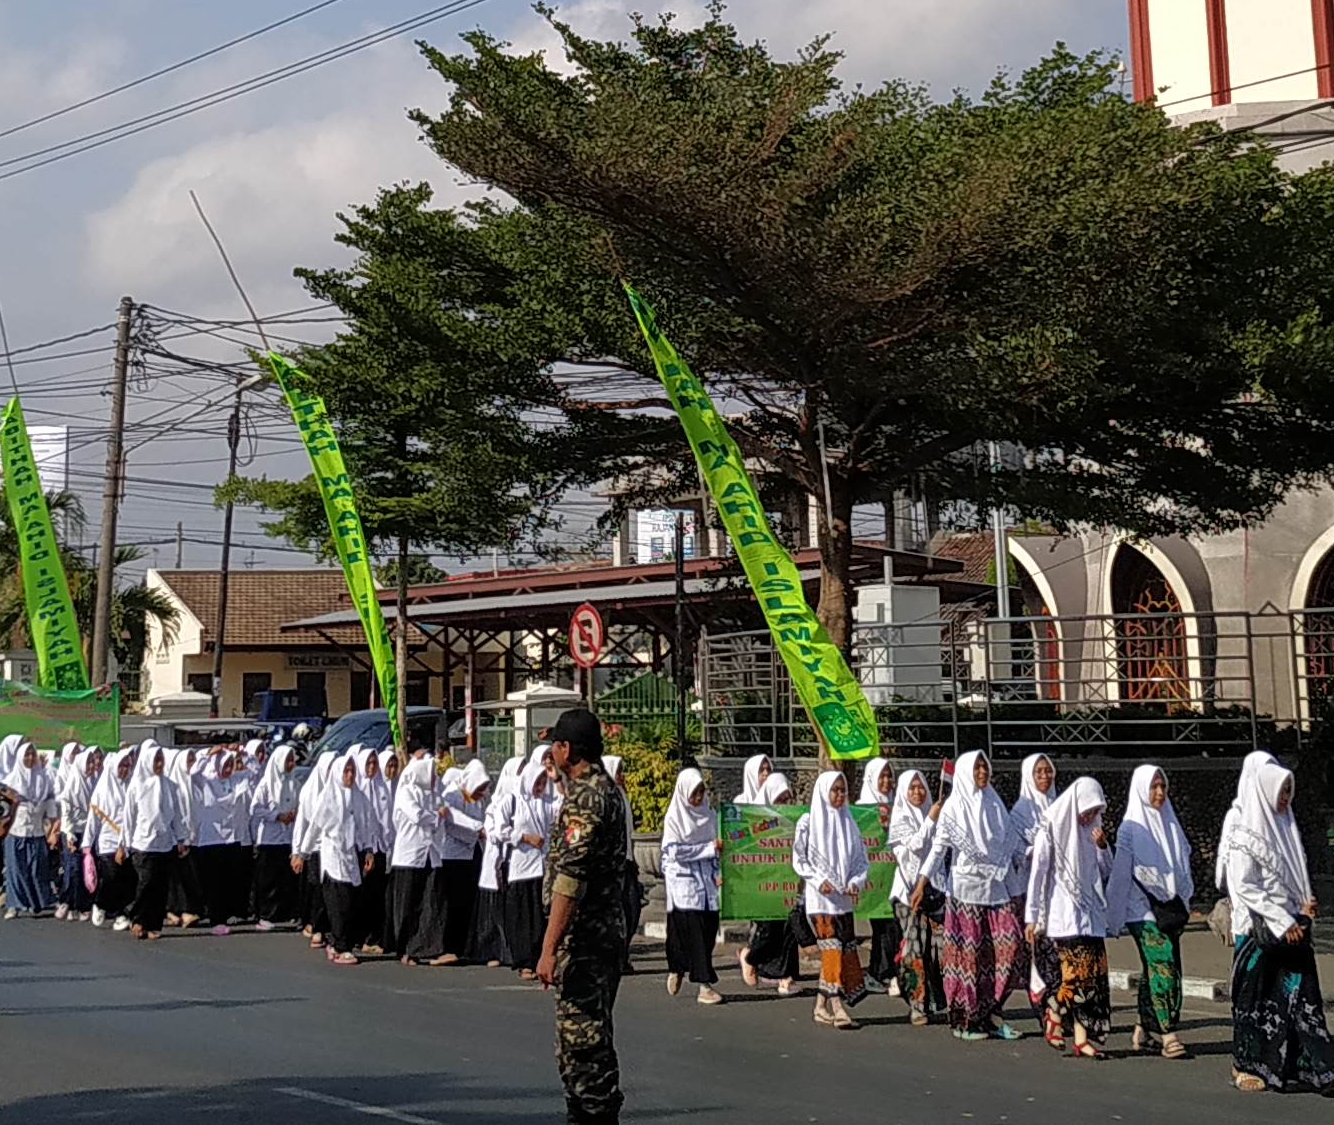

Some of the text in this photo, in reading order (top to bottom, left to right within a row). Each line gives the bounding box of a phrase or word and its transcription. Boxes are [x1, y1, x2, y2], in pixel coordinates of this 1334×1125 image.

[759, 561, 846, 703] ISLAMIYAH
[758, 838, 793, 849] SANT
[731, 853, 777, 864] UNTUK
